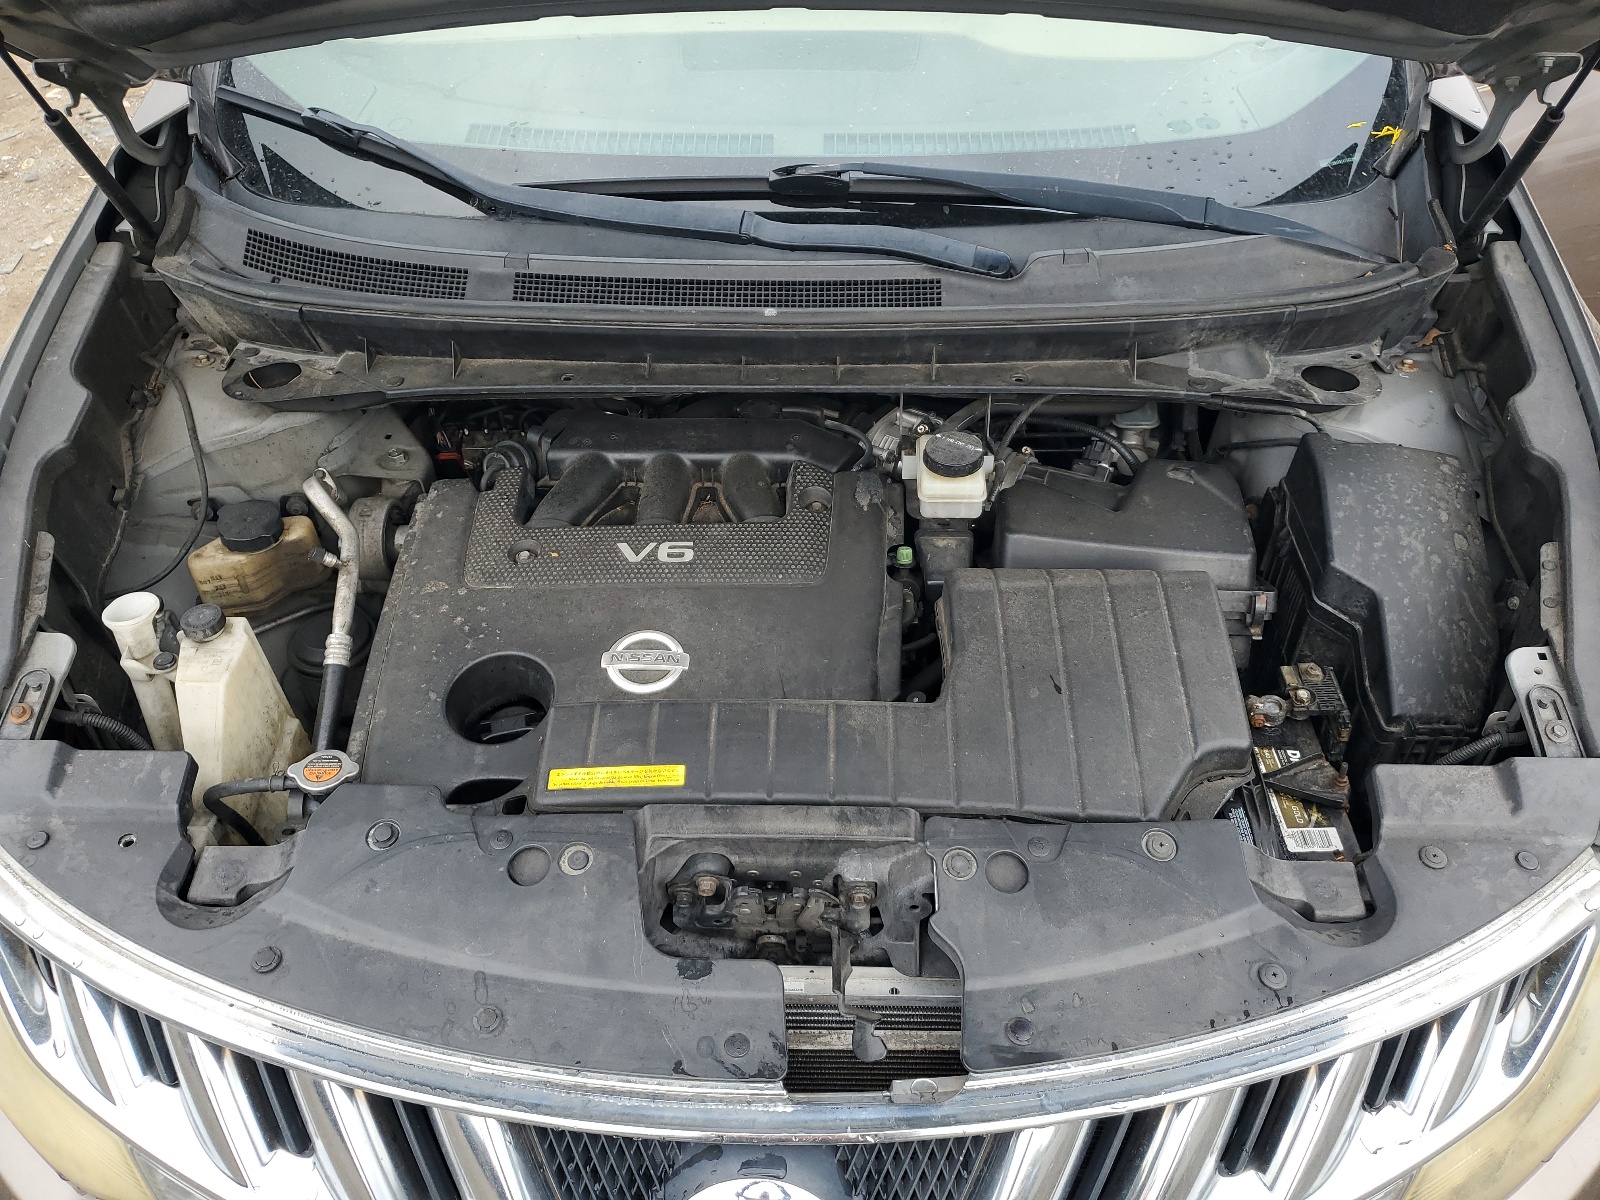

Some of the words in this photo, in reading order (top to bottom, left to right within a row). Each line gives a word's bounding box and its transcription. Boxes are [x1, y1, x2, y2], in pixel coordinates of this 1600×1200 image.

[617, 541, 694, 563] V6
[610, 652, 681, 664] NISSAN
[1291, 805, 1304, 824] GOLD
